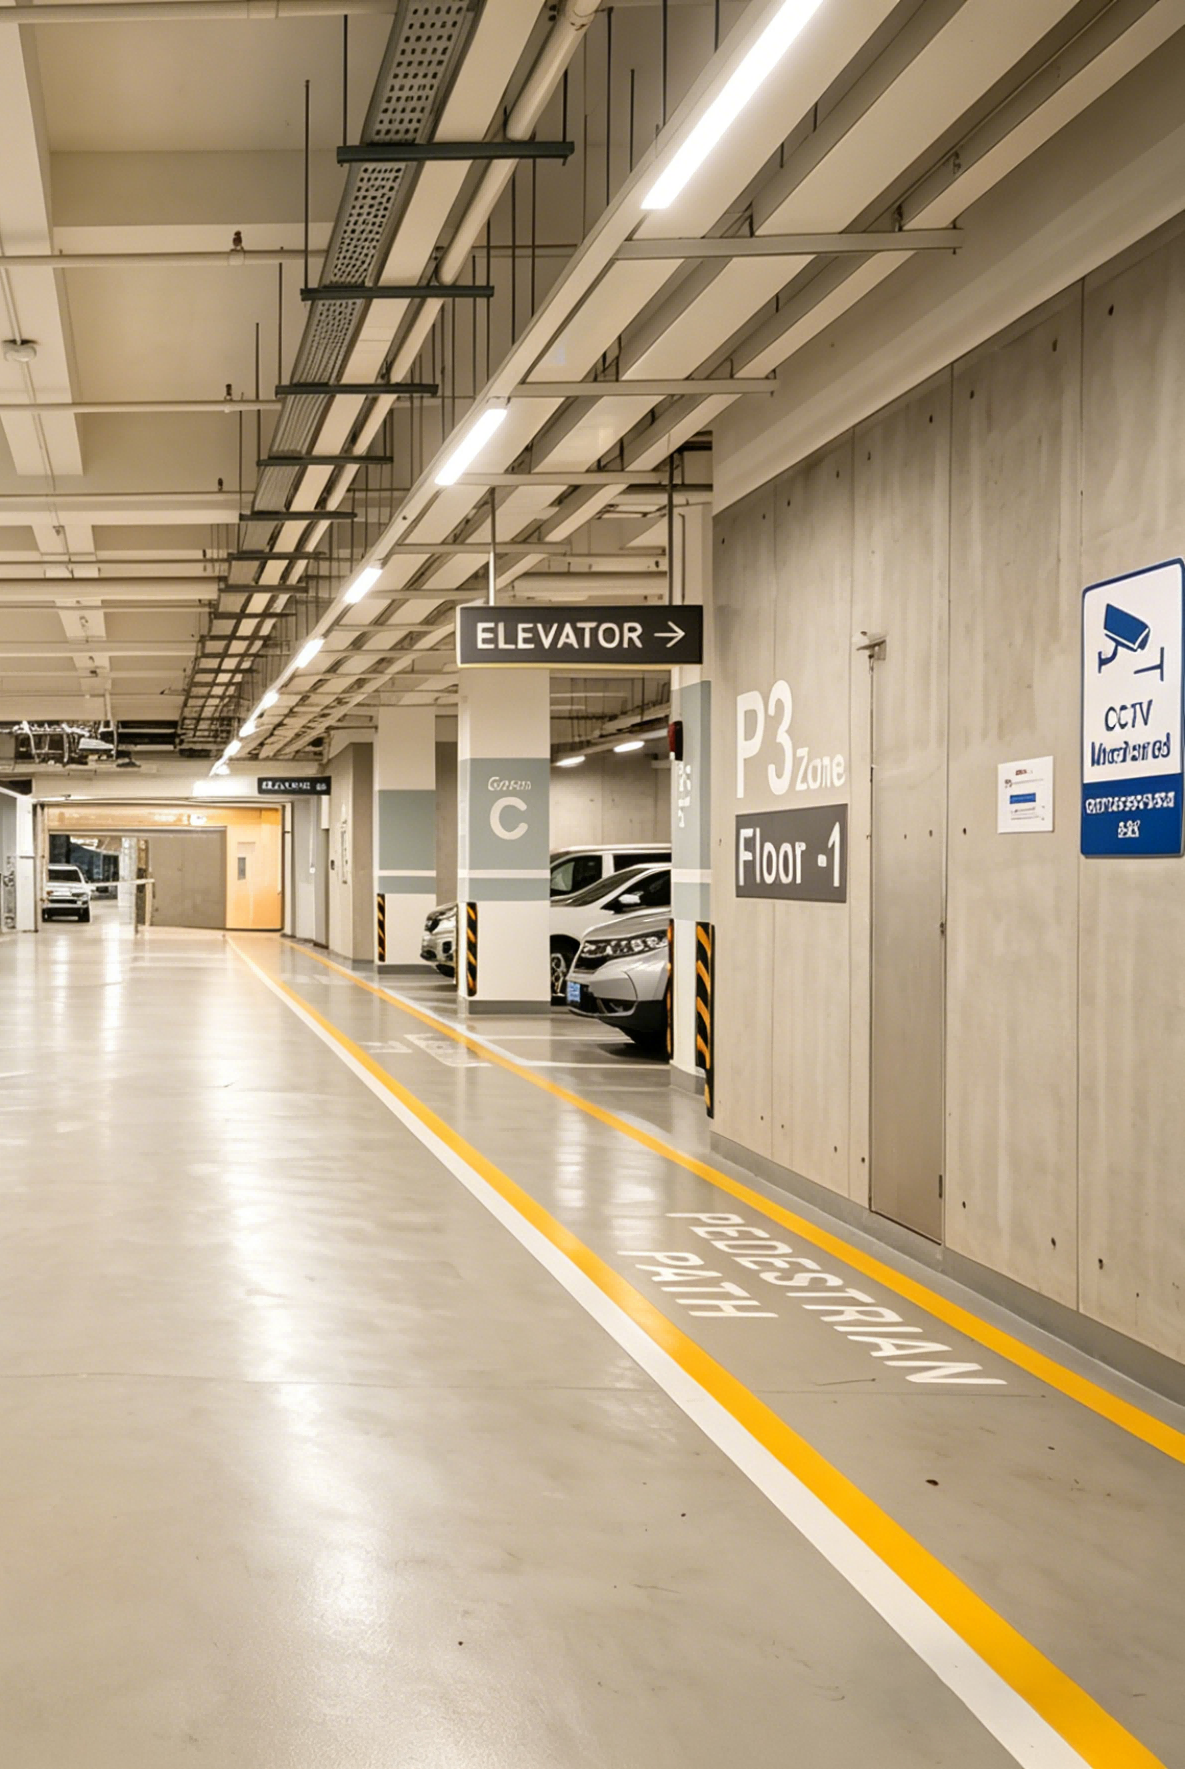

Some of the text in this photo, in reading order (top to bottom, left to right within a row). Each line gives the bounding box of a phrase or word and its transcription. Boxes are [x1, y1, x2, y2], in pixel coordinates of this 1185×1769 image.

[476, 621, 643, 650] ELEVATOR
[736, 679, 793, 799] P3
[795, 747, 846, 791] Zone
[1104, 699, 1153, 732] CCTV
[489, 796, 529, 840] C
[738, 821, 841, 887] Floor -1
[616, 1250, 779, 1319] PATH
[665, 1212, 1008, 1385] PEDESTRIAN
